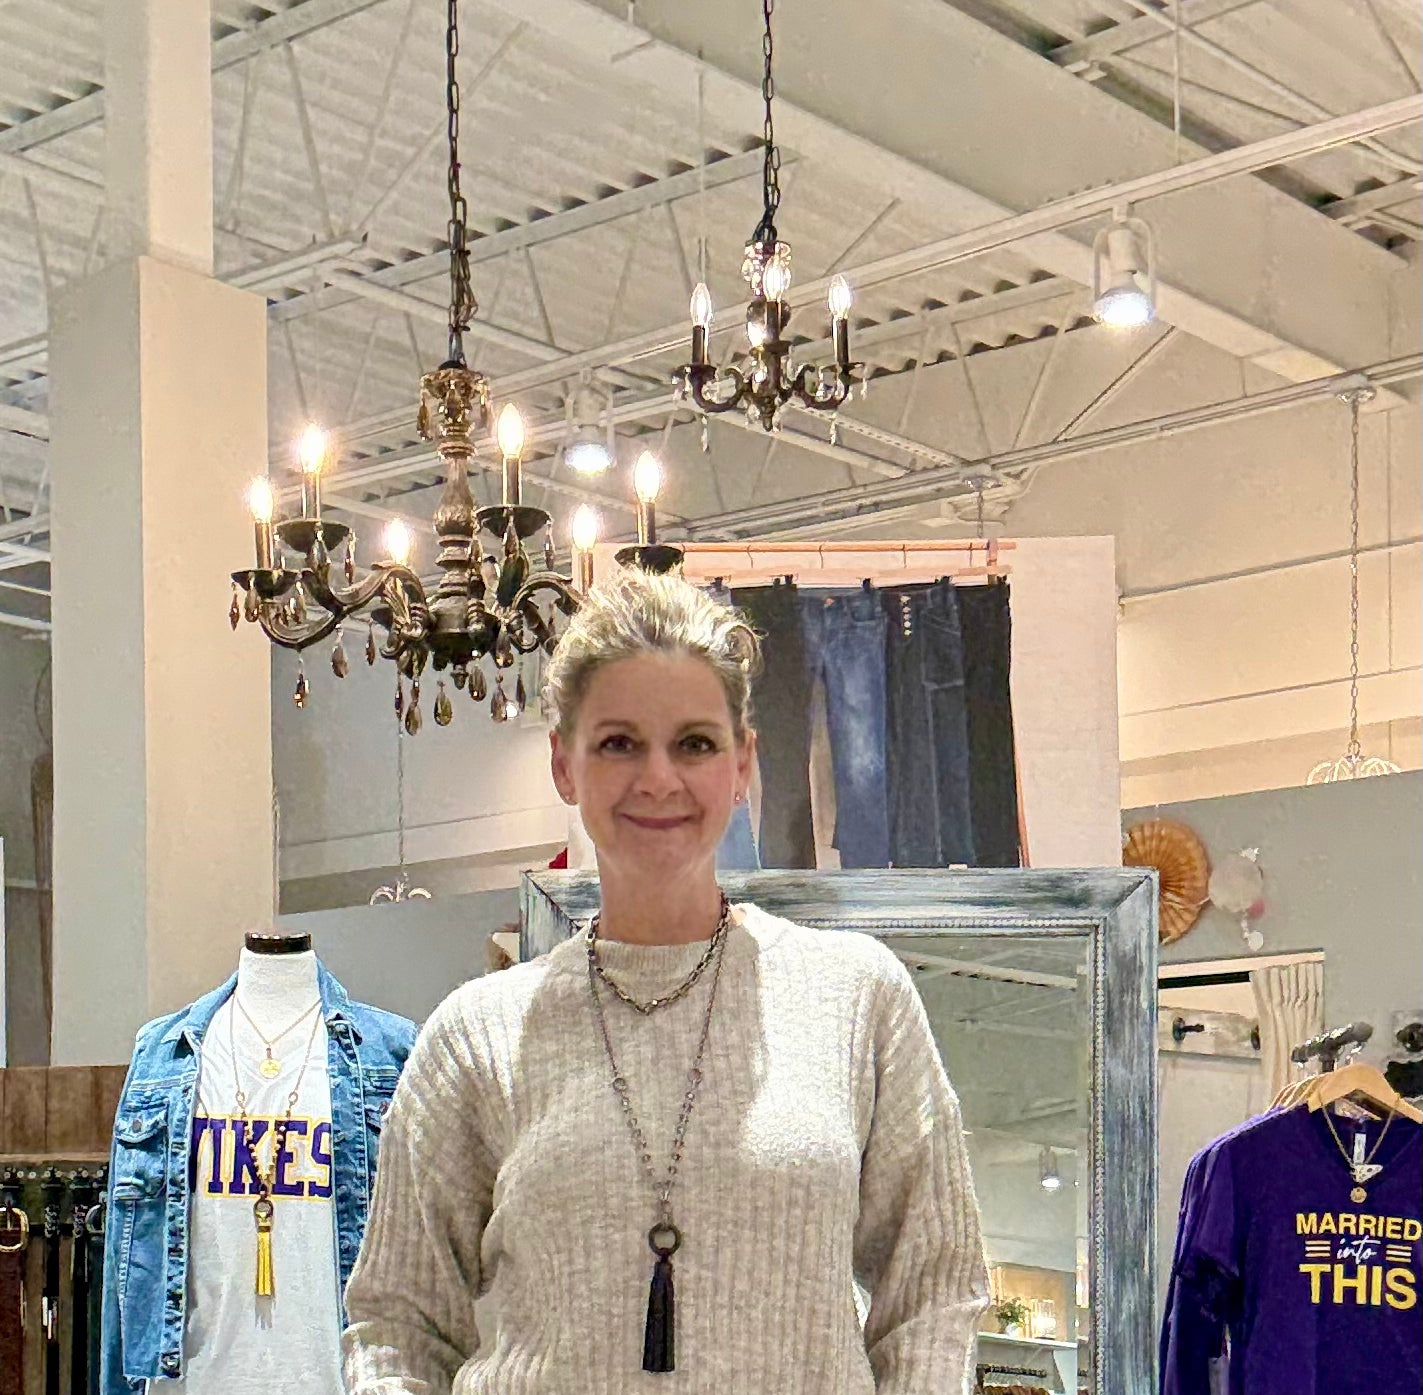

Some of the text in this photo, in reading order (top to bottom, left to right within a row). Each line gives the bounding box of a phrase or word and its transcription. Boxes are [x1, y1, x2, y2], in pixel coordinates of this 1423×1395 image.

[1296, 1212, 1422, 1241] MARRIED
[1337, 1235, 1381, 1264] into
[1299, 1263, 1417, 1310] THIS
